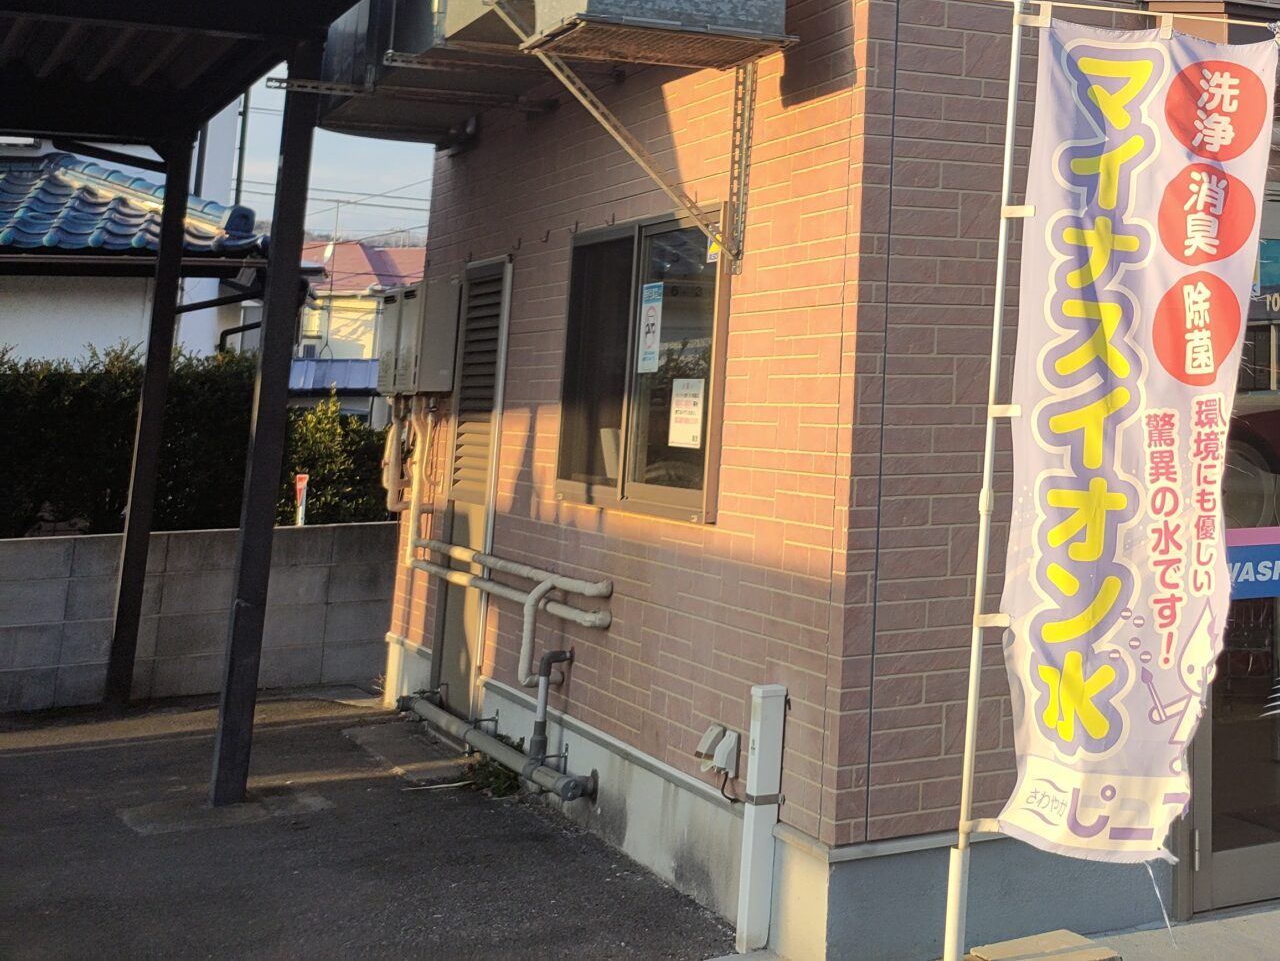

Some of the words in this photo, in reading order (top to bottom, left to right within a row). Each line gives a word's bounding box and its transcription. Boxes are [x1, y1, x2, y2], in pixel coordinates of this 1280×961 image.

[1191, 68, 1240, 153] 洗浄
[1183, 170, 1227, 258] 消臭
[1182, 280, 1215, 376] 除菌
[1038, 57, 1154, 742] マイナスイオン水
[1145, 412, 1183, 664] 驚異の水です！
[1193, 397, 1227, 592] 環境にも優しい
[1025, 787, 1068, 818] さわやか
